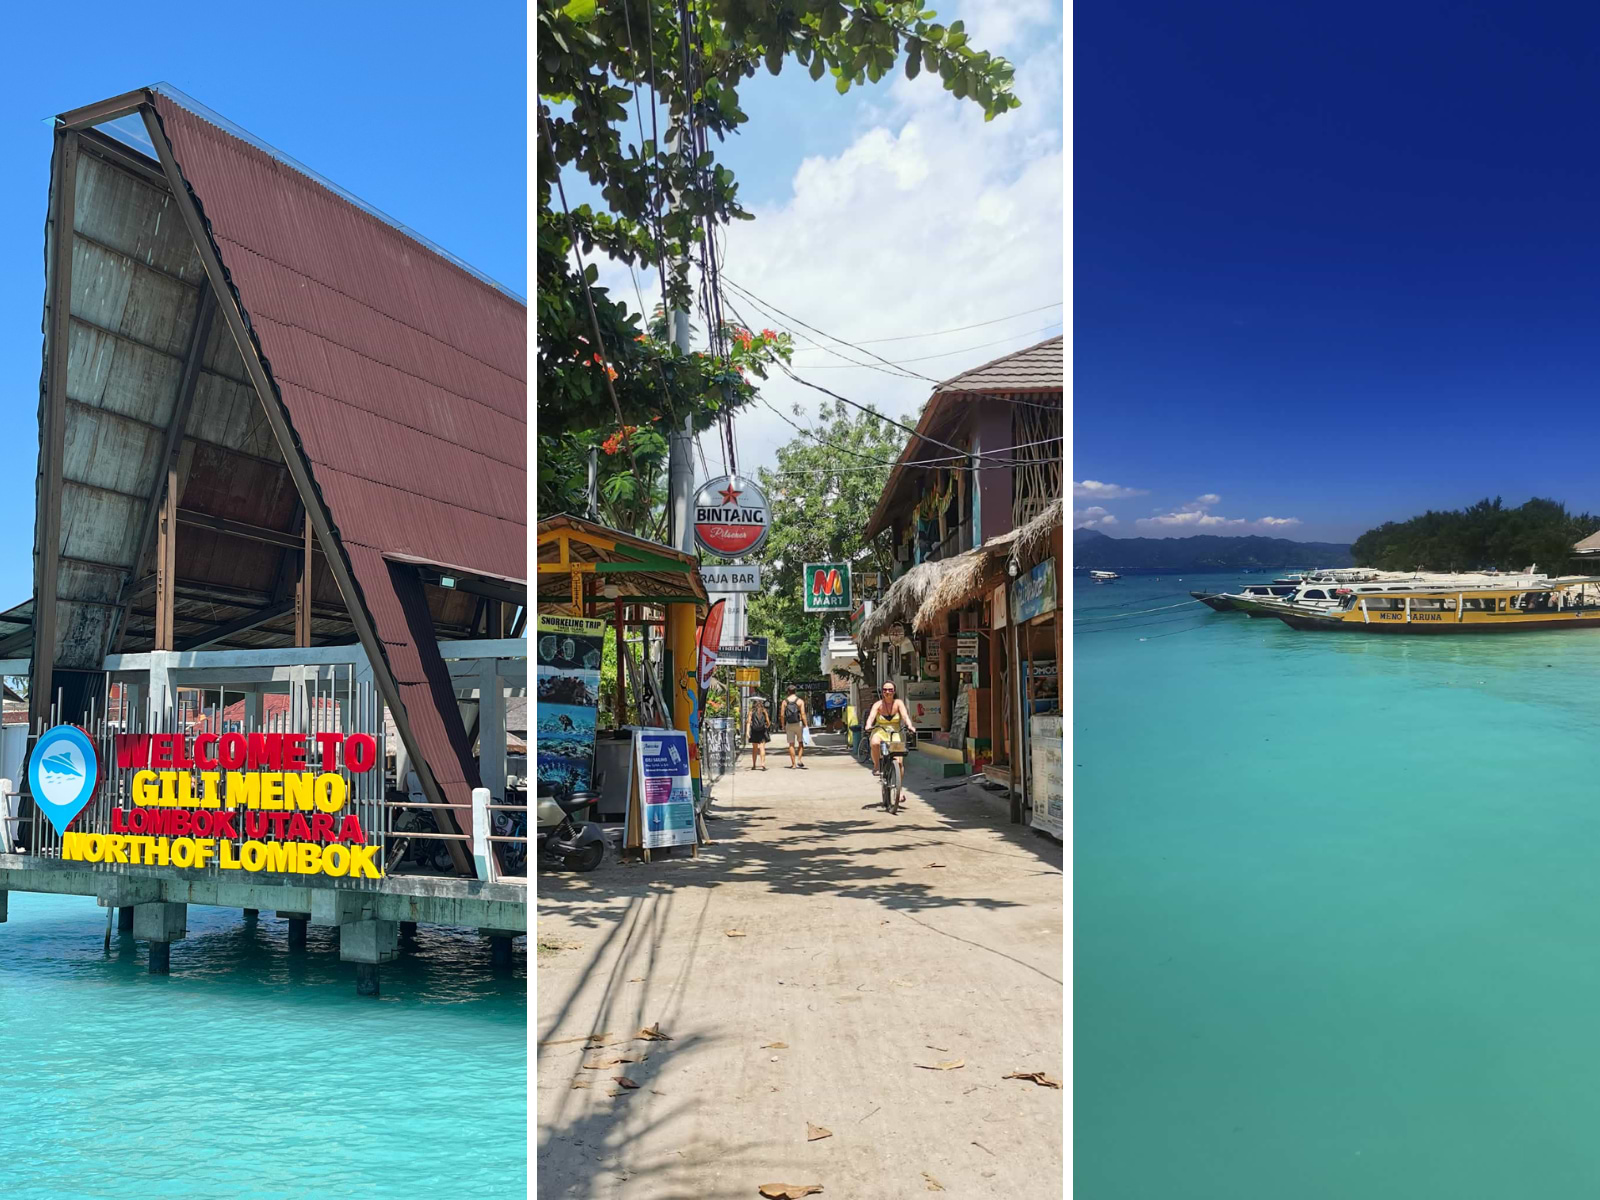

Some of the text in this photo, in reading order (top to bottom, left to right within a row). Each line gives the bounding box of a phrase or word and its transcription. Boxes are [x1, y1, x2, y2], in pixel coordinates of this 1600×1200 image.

[697, 508, 764, 523] BINTANG
[701, 573, 755, 584] RAJA BAR
[812, 596, 844, 606] MART
[541, 616, 602, 629] SNORKELING TRIP
[1380, 612, 1442, 621] MENO ARUNA
[116, 731, 377, 773] WELCOME TO
[132, 770, 348, 813] GILI MENO
[112, 808, 367, 844] LOMBOK UTARA
[62, 831, 385, 879] NORTH OF LOMBOK
